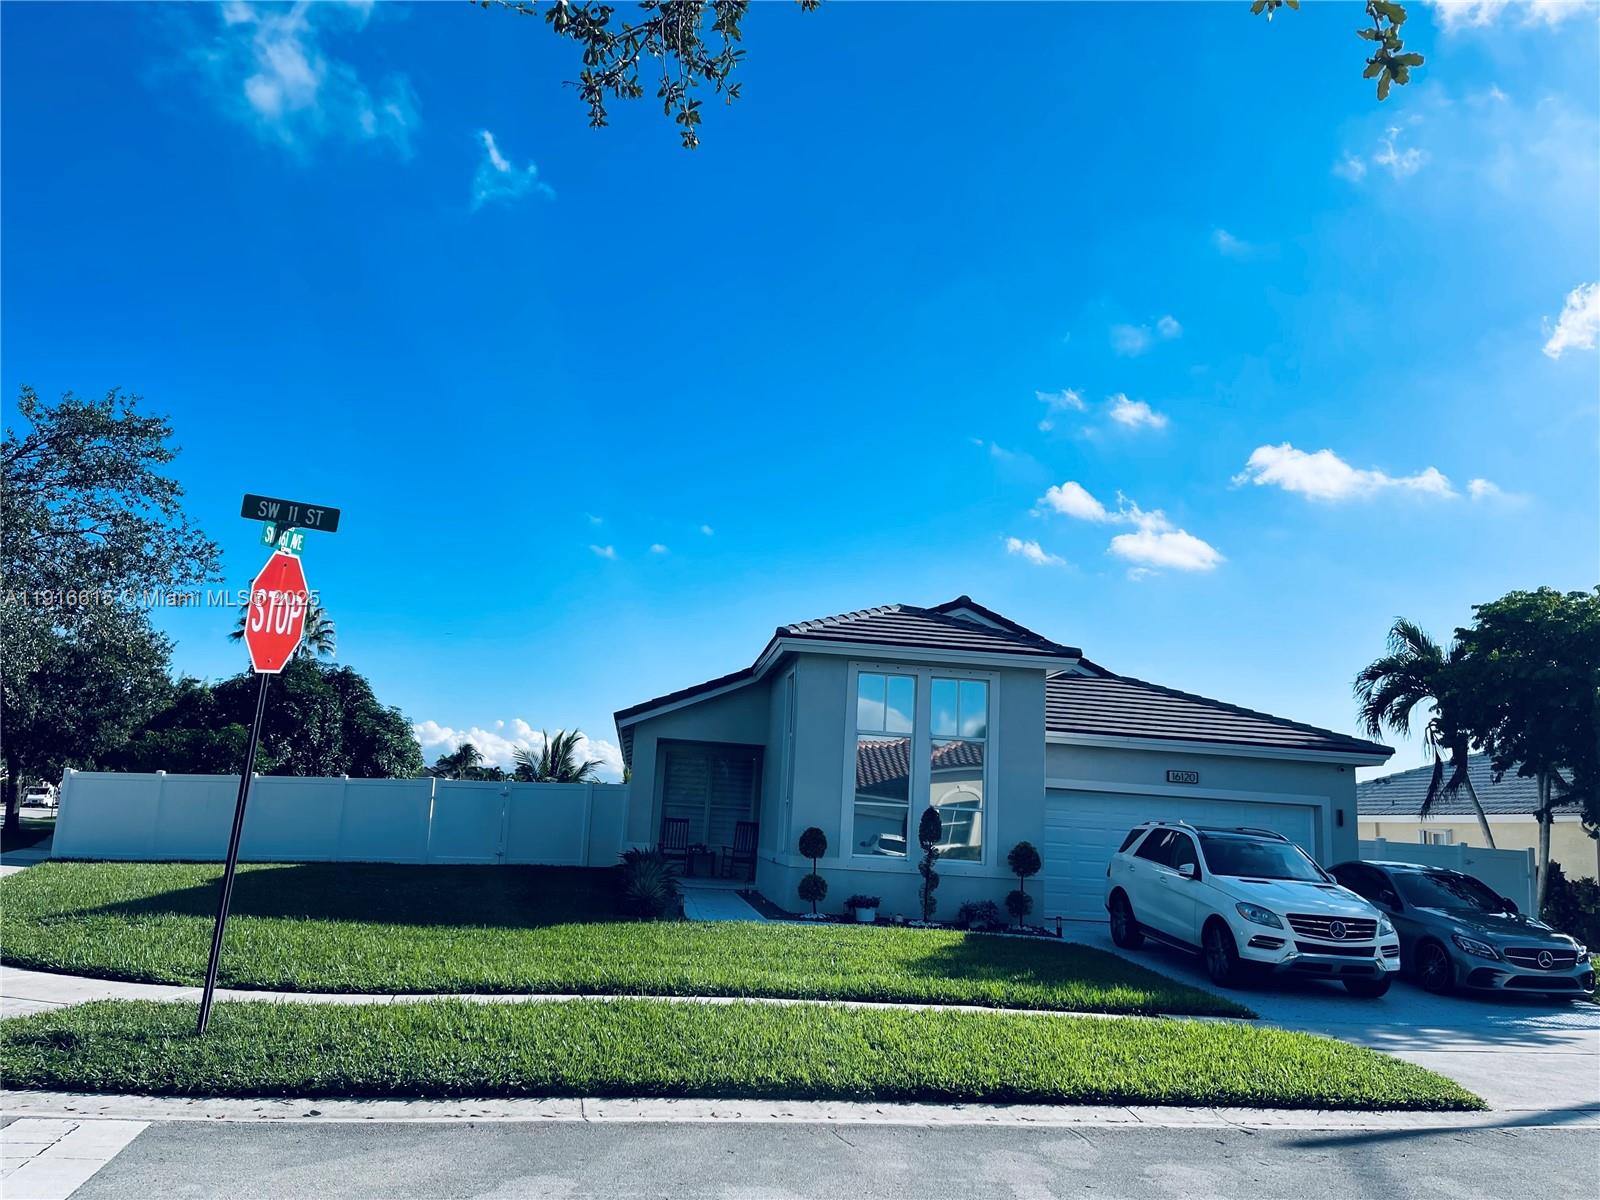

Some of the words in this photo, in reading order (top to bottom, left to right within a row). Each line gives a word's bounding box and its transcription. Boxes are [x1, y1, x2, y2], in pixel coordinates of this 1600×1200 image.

[257, 500, 280, 519] SW
[288, 505, 299, 522] 11
[305, 508, 325, 526] ST
[251, 588, 304, 635] STOP
[1172, 772, 1196, 782] 16120
